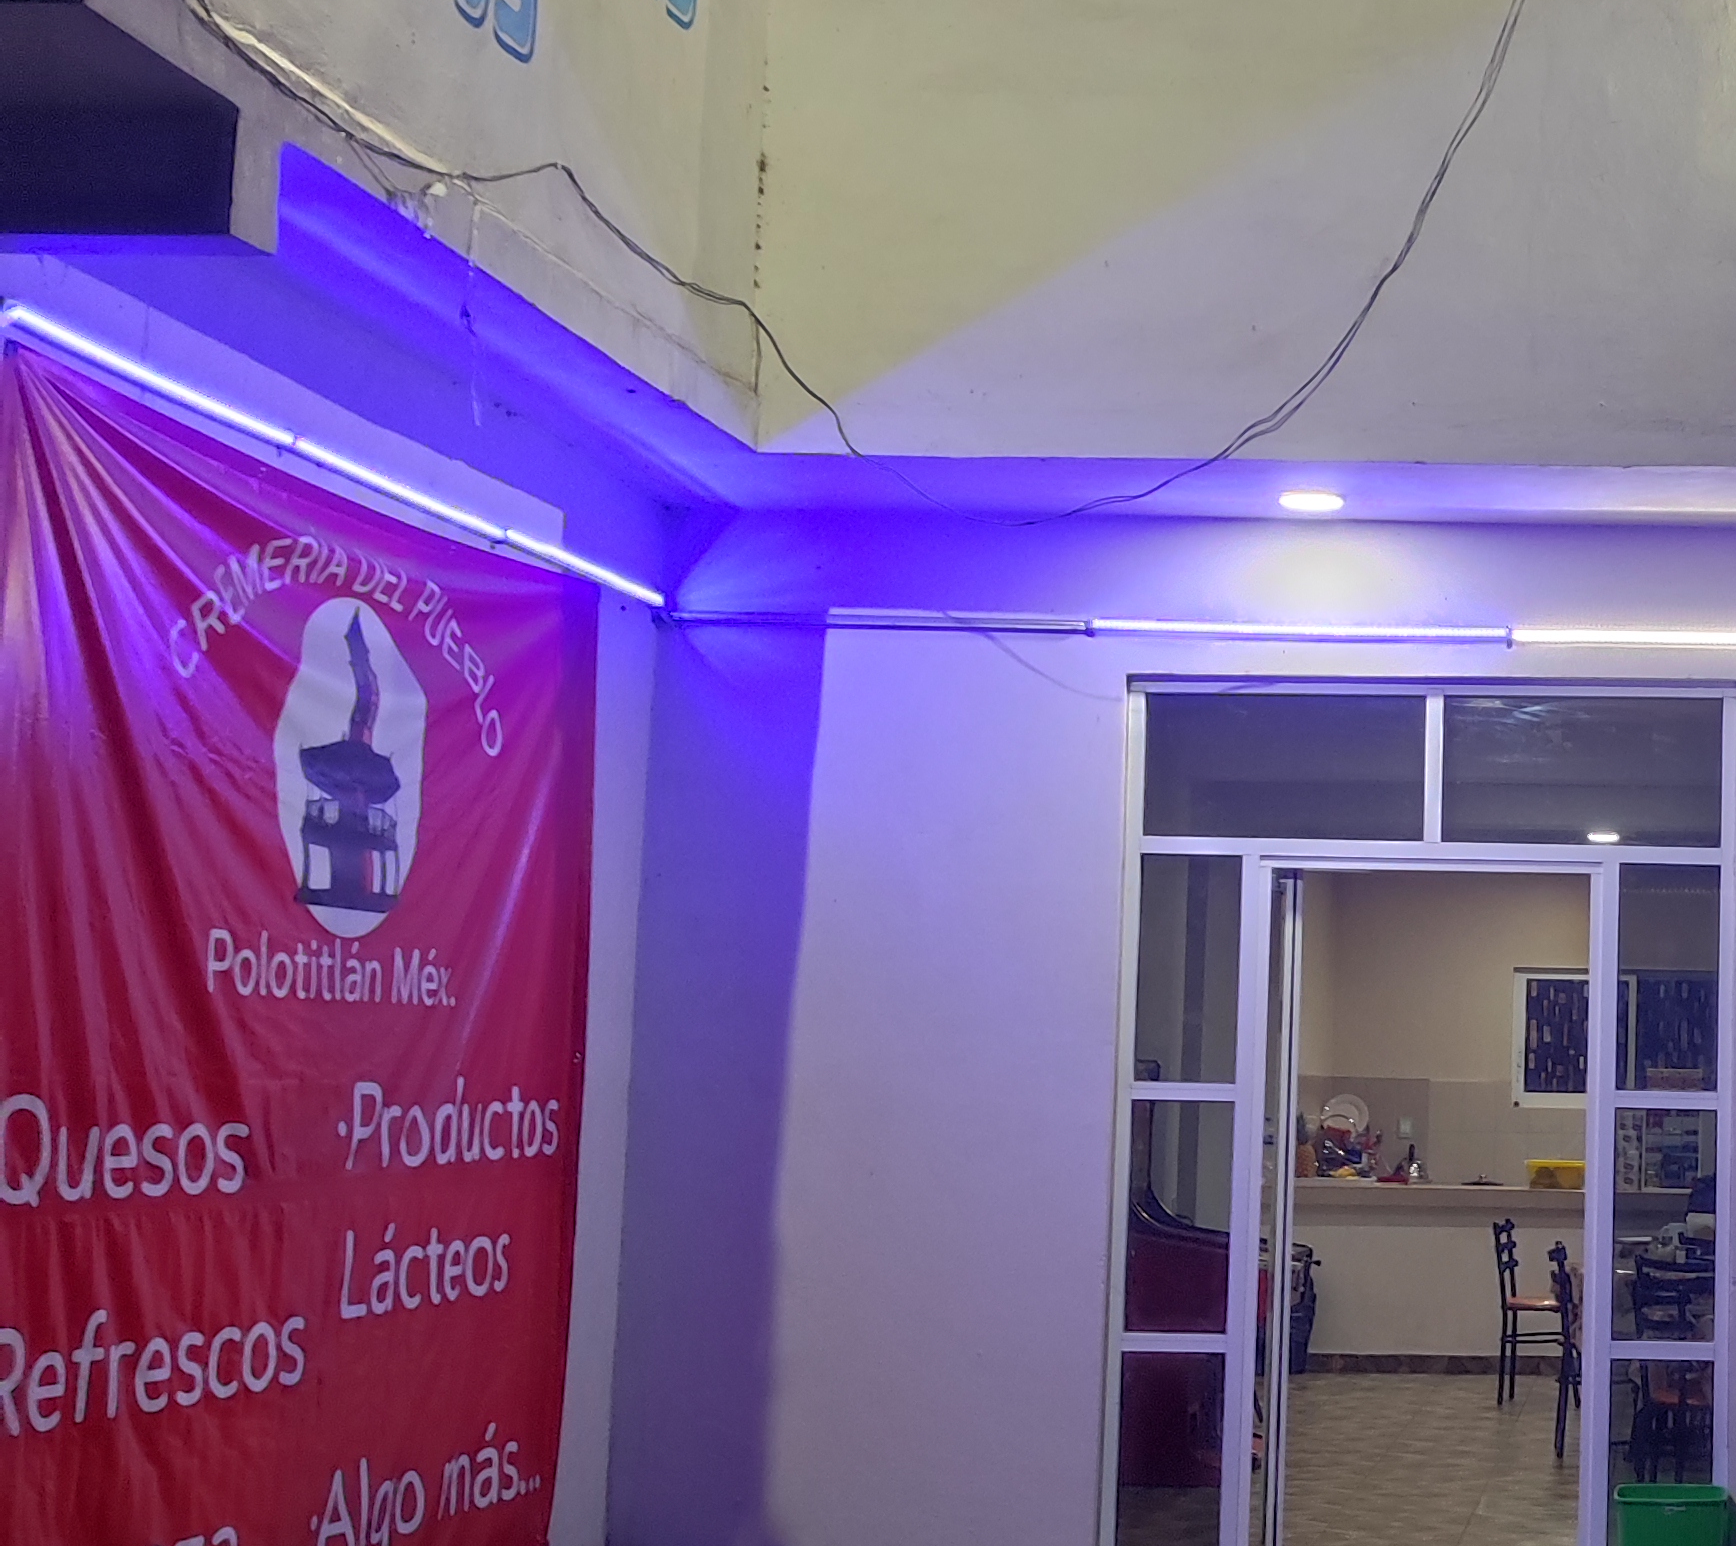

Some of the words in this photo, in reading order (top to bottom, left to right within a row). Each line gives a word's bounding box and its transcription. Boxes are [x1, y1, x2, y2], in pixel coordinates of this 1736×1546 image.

[168, 534, 350, 679] CREMERIA
[351, 551, 408, 613] DEL
[407, 578, 504, 757] PUEBLO
[206, 928, 383, 1003] Polotitlán
[391, 947, 456, 1008] Méx.
[0, 1093, 251, 1208] Quesos
[344, 1075, 560, 1171] Productos
[340, 1222, 511, 1320] Lácteos
[0, 1309, 306, 1437] Refrescos
